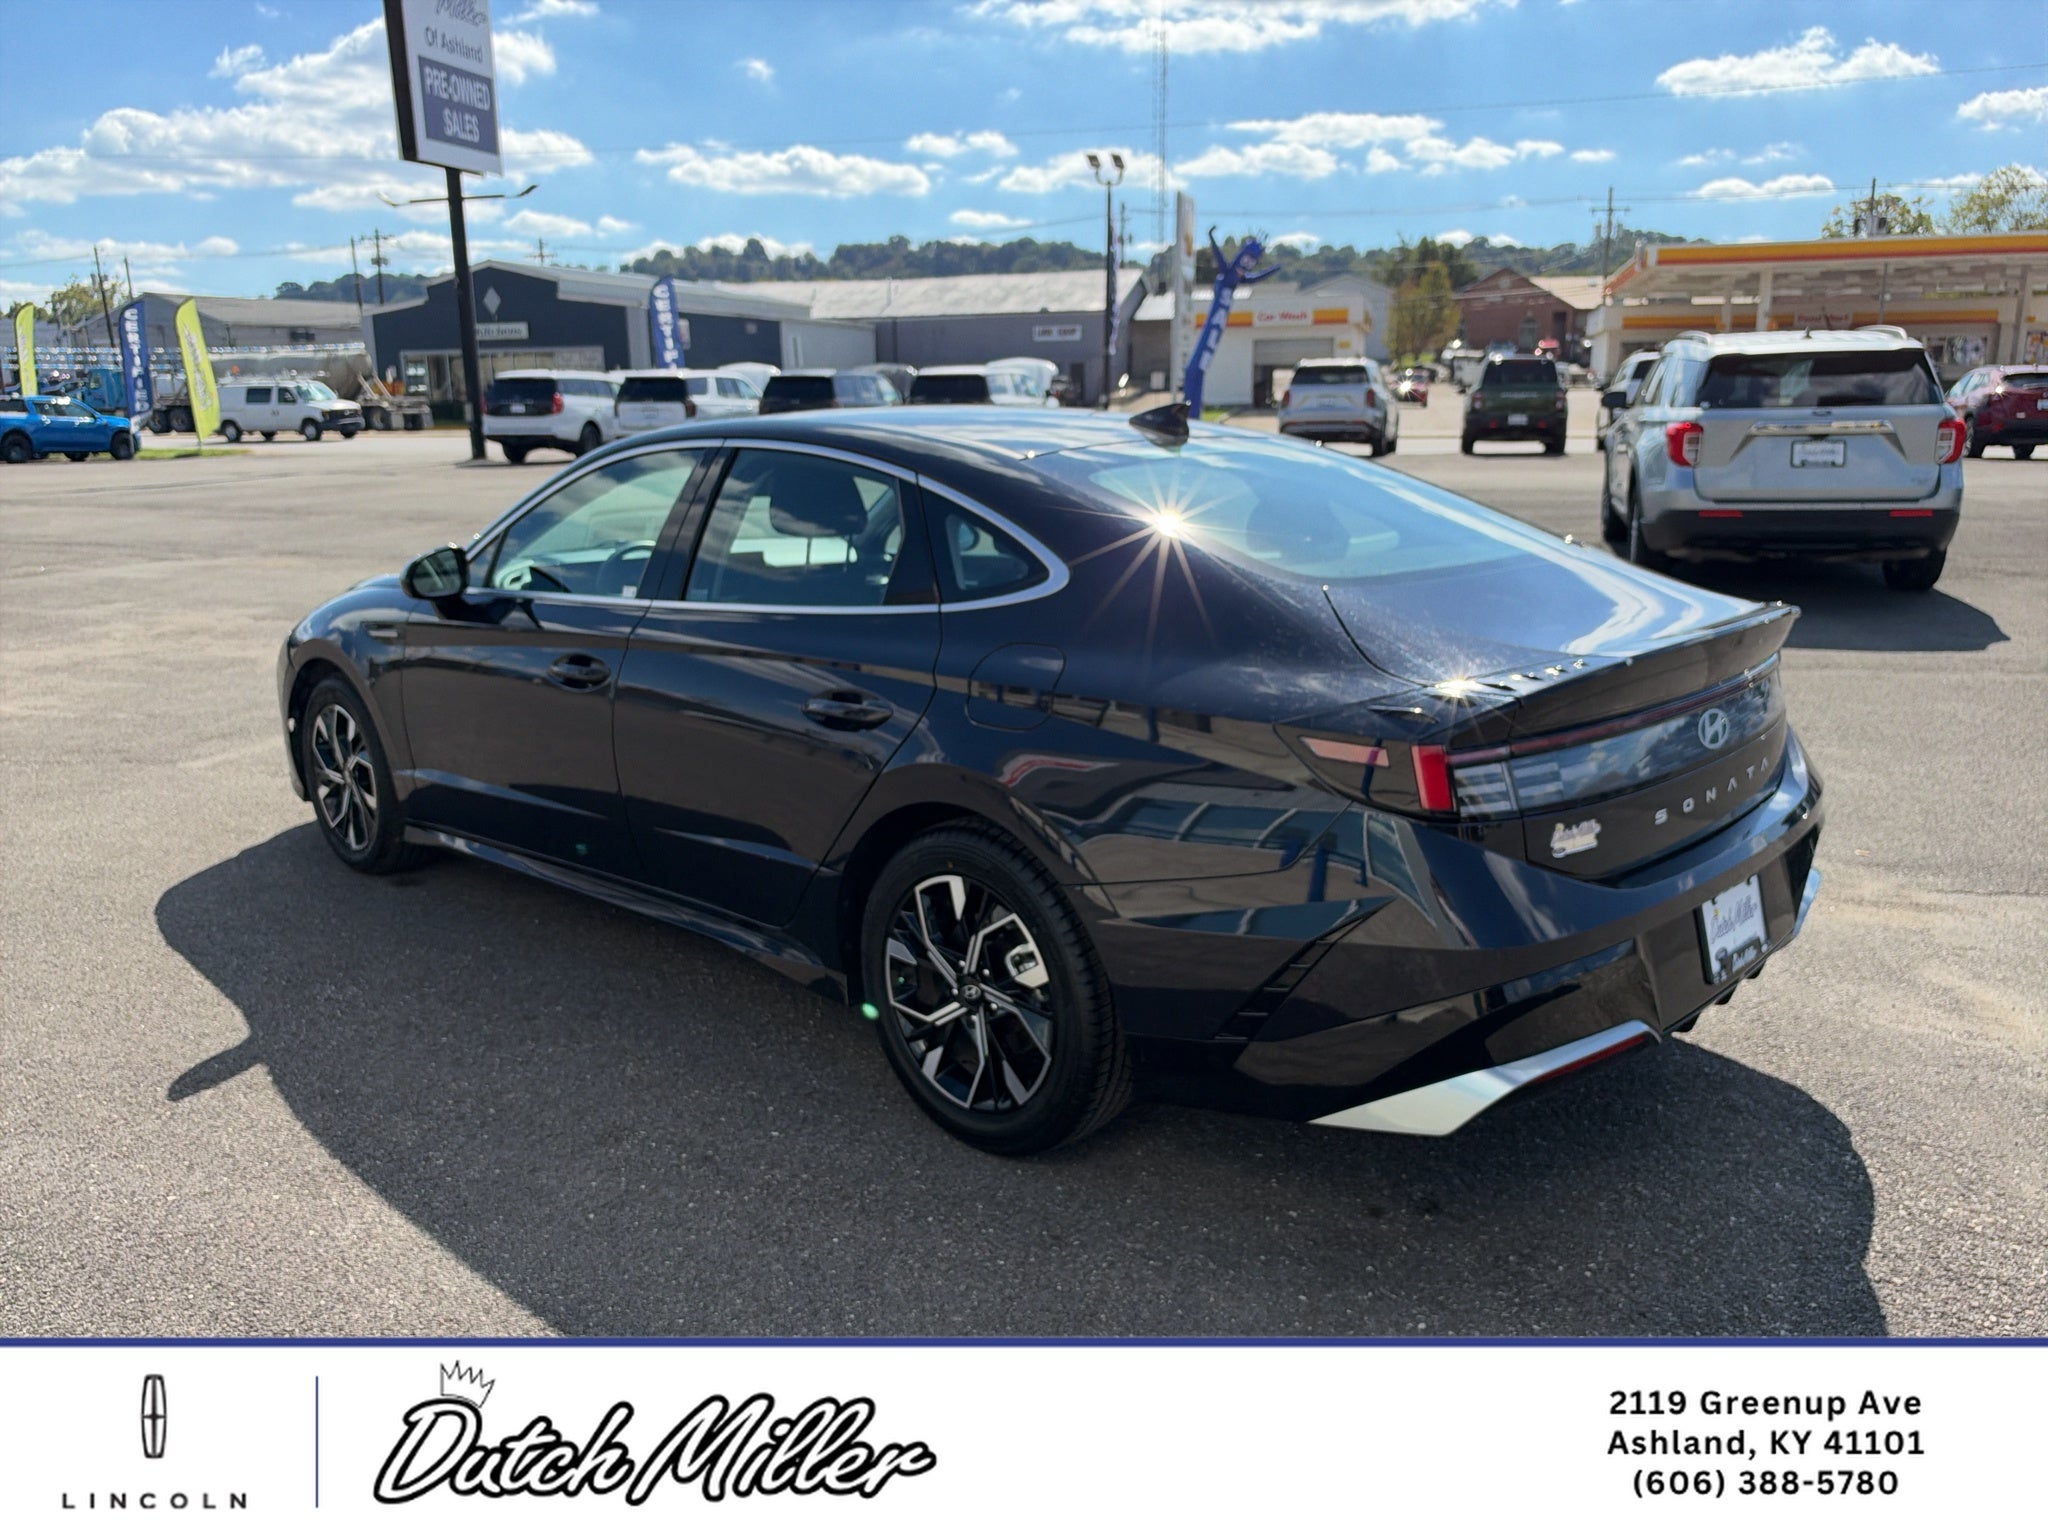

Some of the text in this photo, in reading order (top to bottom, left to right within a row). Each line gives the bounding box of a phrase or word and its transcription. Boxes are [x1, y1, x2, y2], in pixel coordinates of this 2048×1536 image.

[441, 32, 484, 63] Ashland
[424, 65, 491, 111] PRE-OWNED
[443, 108, 480, 143] SALES
[124, 308, 150, 412] CERTIFIED
[1655, 757, 1768, 825] SONATA
